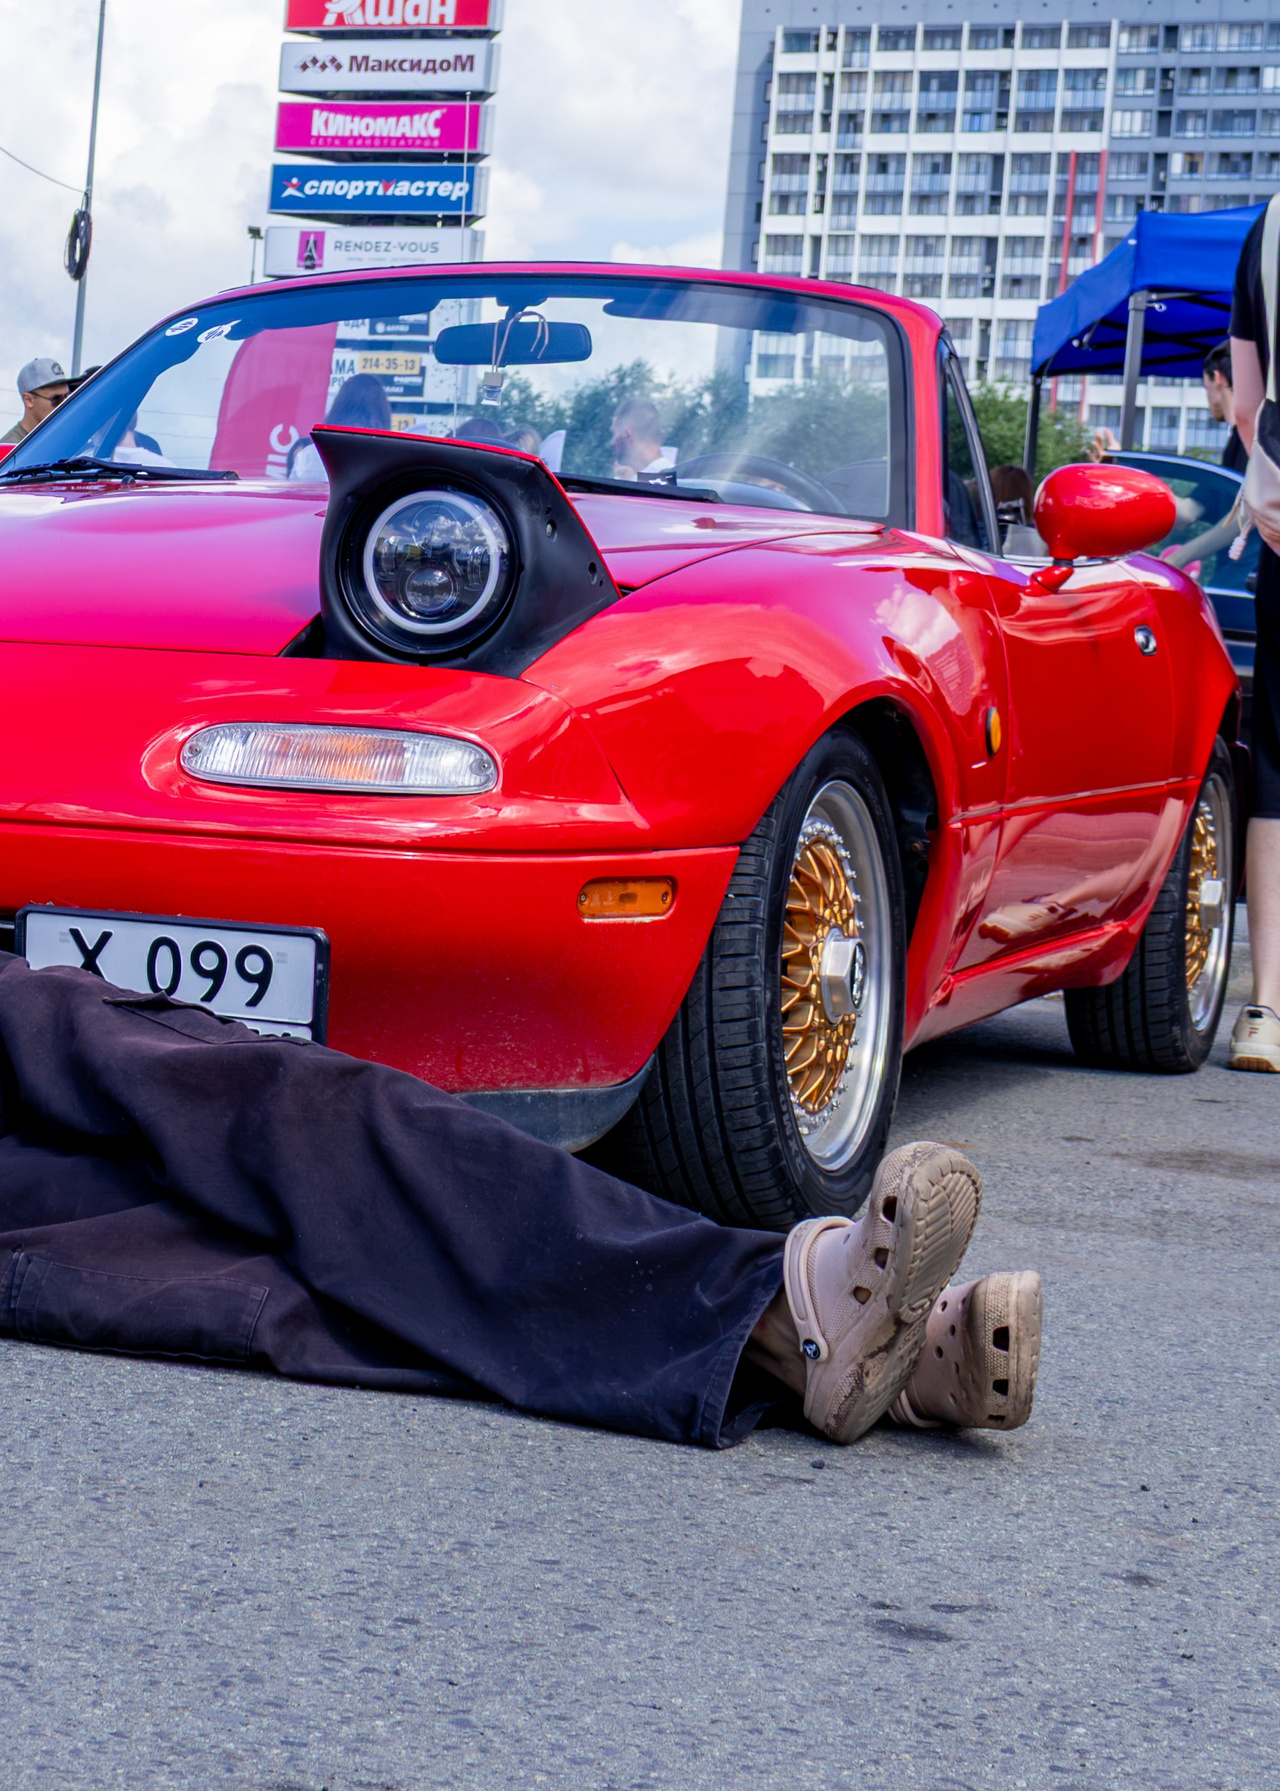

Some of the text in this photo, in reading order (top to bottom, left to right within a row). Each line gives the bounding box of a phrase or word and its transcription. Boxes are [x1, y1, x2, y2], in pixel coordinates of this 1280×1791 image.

[348, 54, 475, 75] МаксидоМ
[311, 108, 441, 138] КИНОМАКС
[333, 240, 440, 253] RENDEZ-VOUS
[362, 358, 416, 371] 214-35-13
[147, 936, 274, 1007] 099
